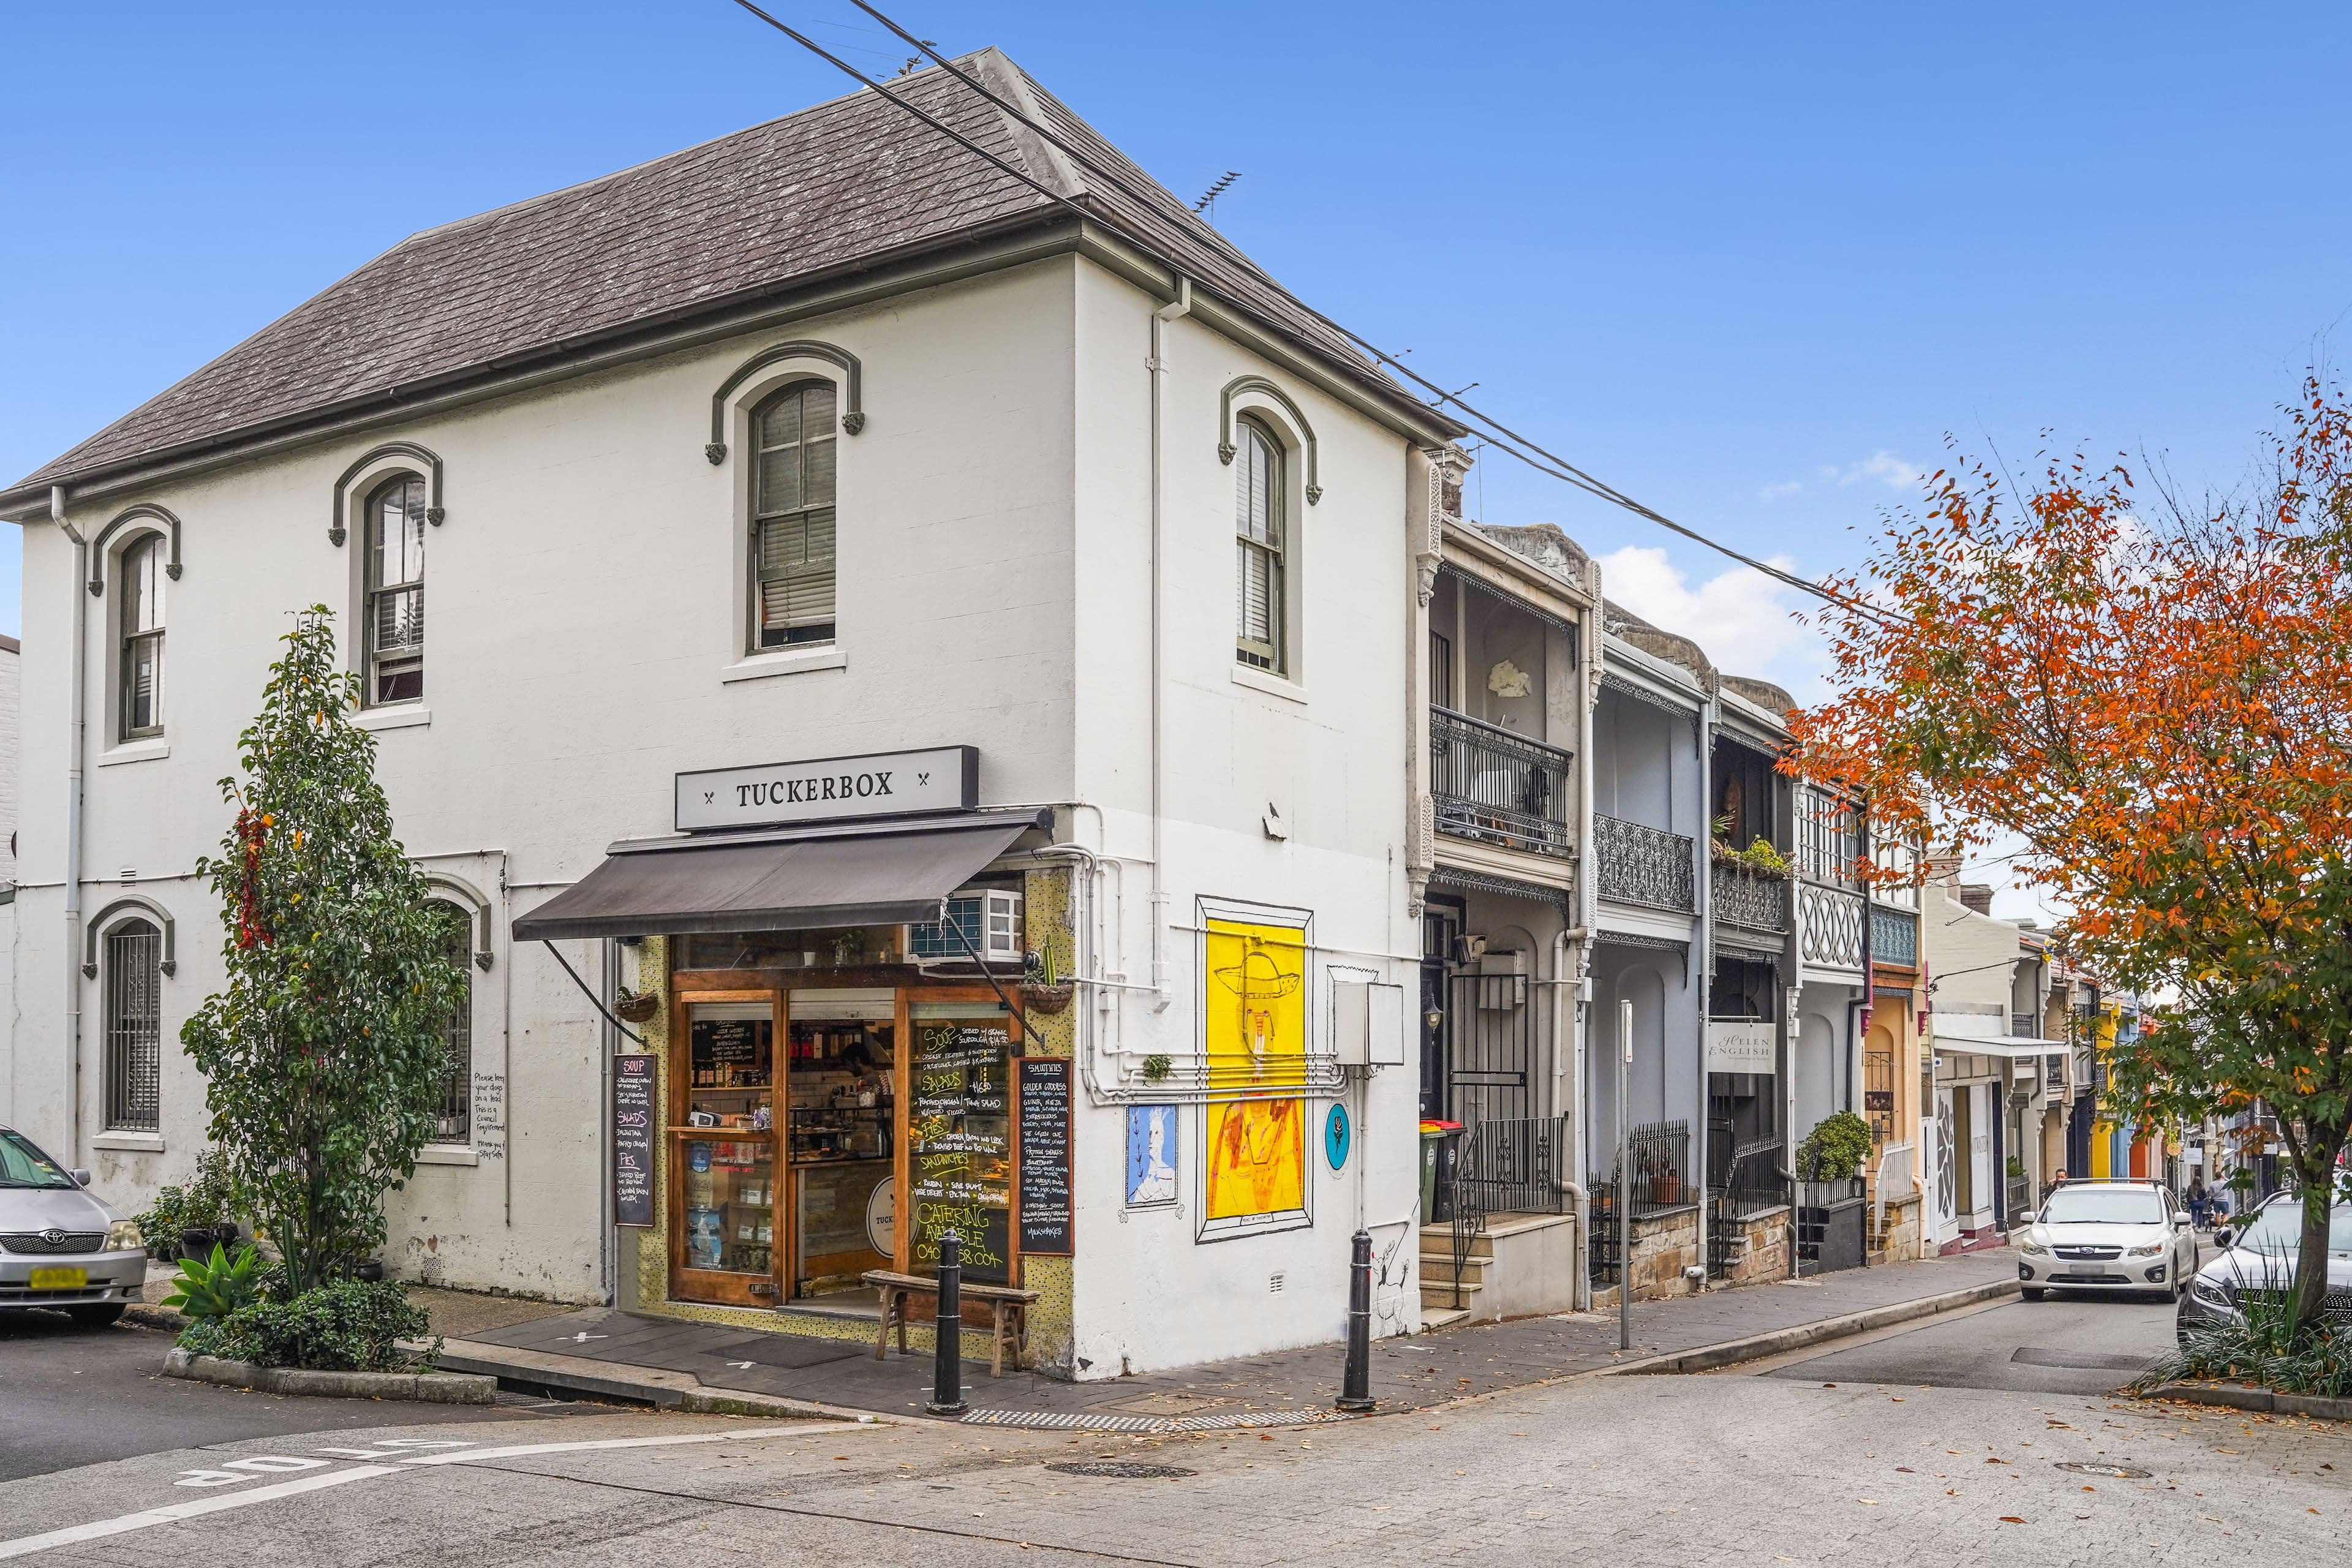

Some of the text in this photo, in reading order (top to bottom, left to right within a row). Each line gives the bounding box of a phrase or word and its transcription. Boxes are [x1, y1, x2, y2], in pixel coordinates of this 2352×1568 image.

[736, 772, 893, 807] TUCKERBOX
[924, 1026, 956, 1050] SOUP
[1719, 1035, 1769, 1047] HELEN
[1709, 1046, 1769, 1057] ENGLISH
[623, 1060, 644, 1072] SOUP
[475, 1072, 494, 1082] Please
[922, 1072, 961, 1091] SALADS
[475, 1084, 503, 1095] your dogs
[1023, 1082, 1067, 1091] GOLDEN GODDESS
[490, 1094, 501, 1103] lead
[964, 1098, 980, 1107] TUNA
[475, 1104, 486, 1114] This
[617, 1110, 647, 1125] SALADS
[477, 1122, 505, 1134] requirement
[921, 1121, 944, 1137] PIES
[1024, 1146, 1044, 1156] PROTEIN
[920, 1152, 969, 1170] SANDWICHES
[917, 1203, 989, 1227] CATERING
[925, 1224, 986, 1252] AVAIBLE
[1027, 1227, 1063, 1239] MILKSHAKES
[172, 1438, 480, 1487] STOP
